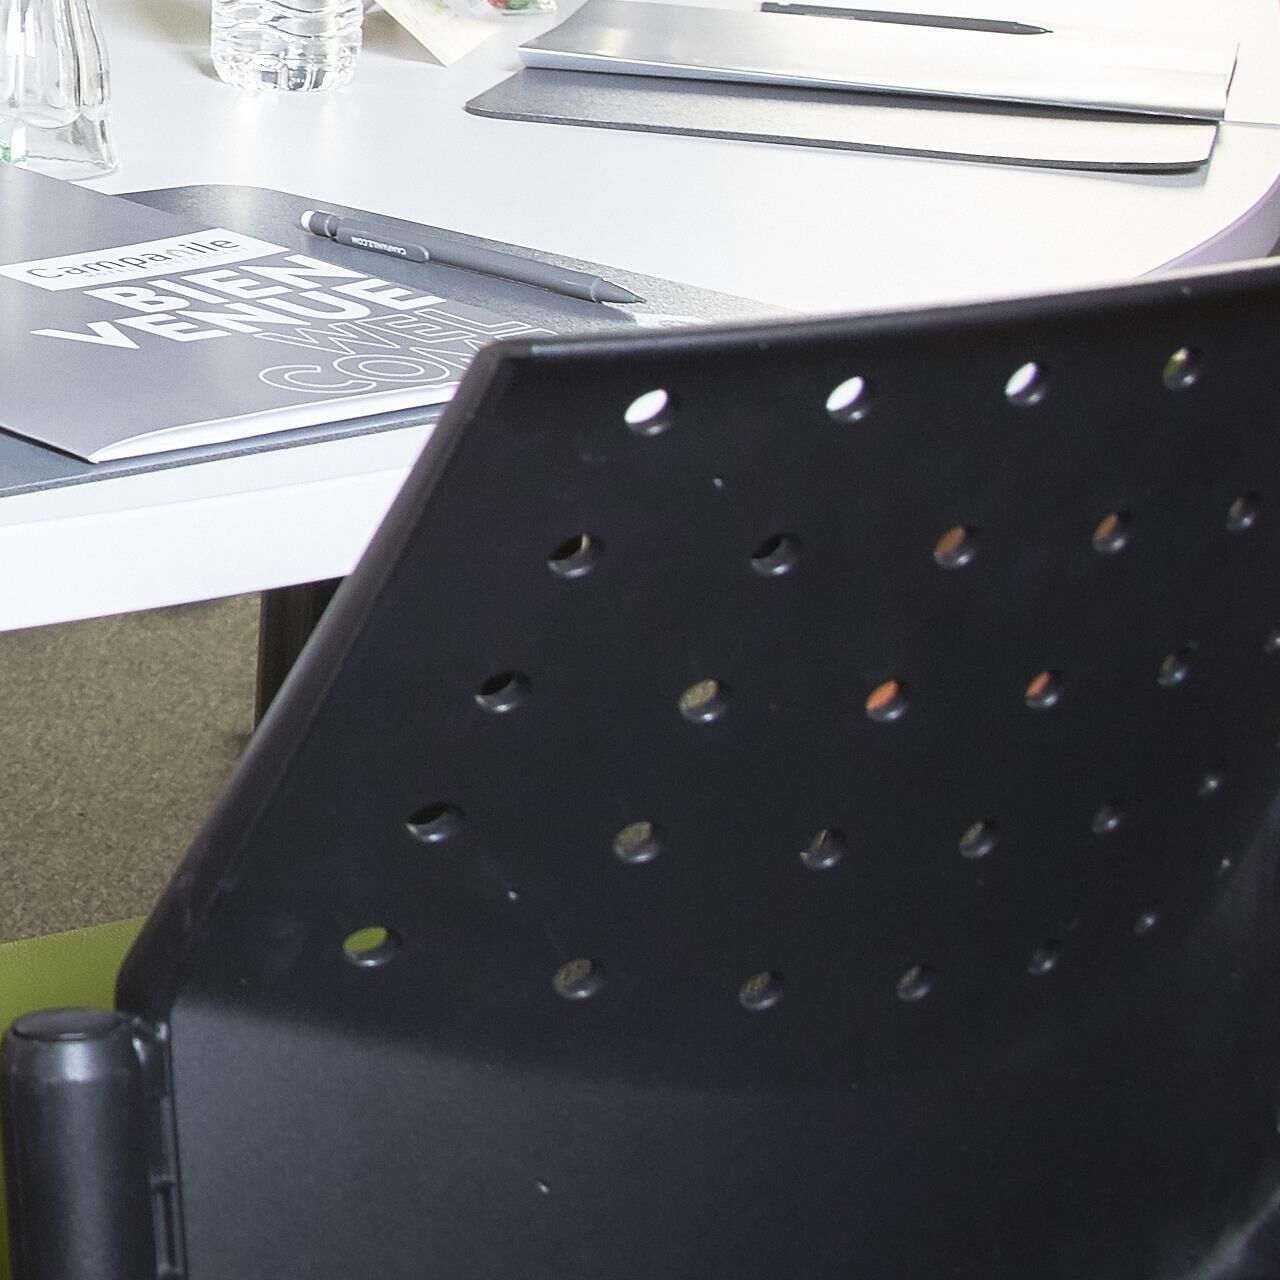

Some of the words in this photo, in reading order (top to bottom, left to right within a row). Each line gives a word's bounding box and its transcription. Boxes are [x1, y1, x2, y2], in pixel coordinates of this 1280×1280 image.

[26, 238, 240, 279] Campanile
[83, 254, 367, 313] BIEN
[29, 278, 446, 349] VENUE
[254, 308, 533, 357] WEL
